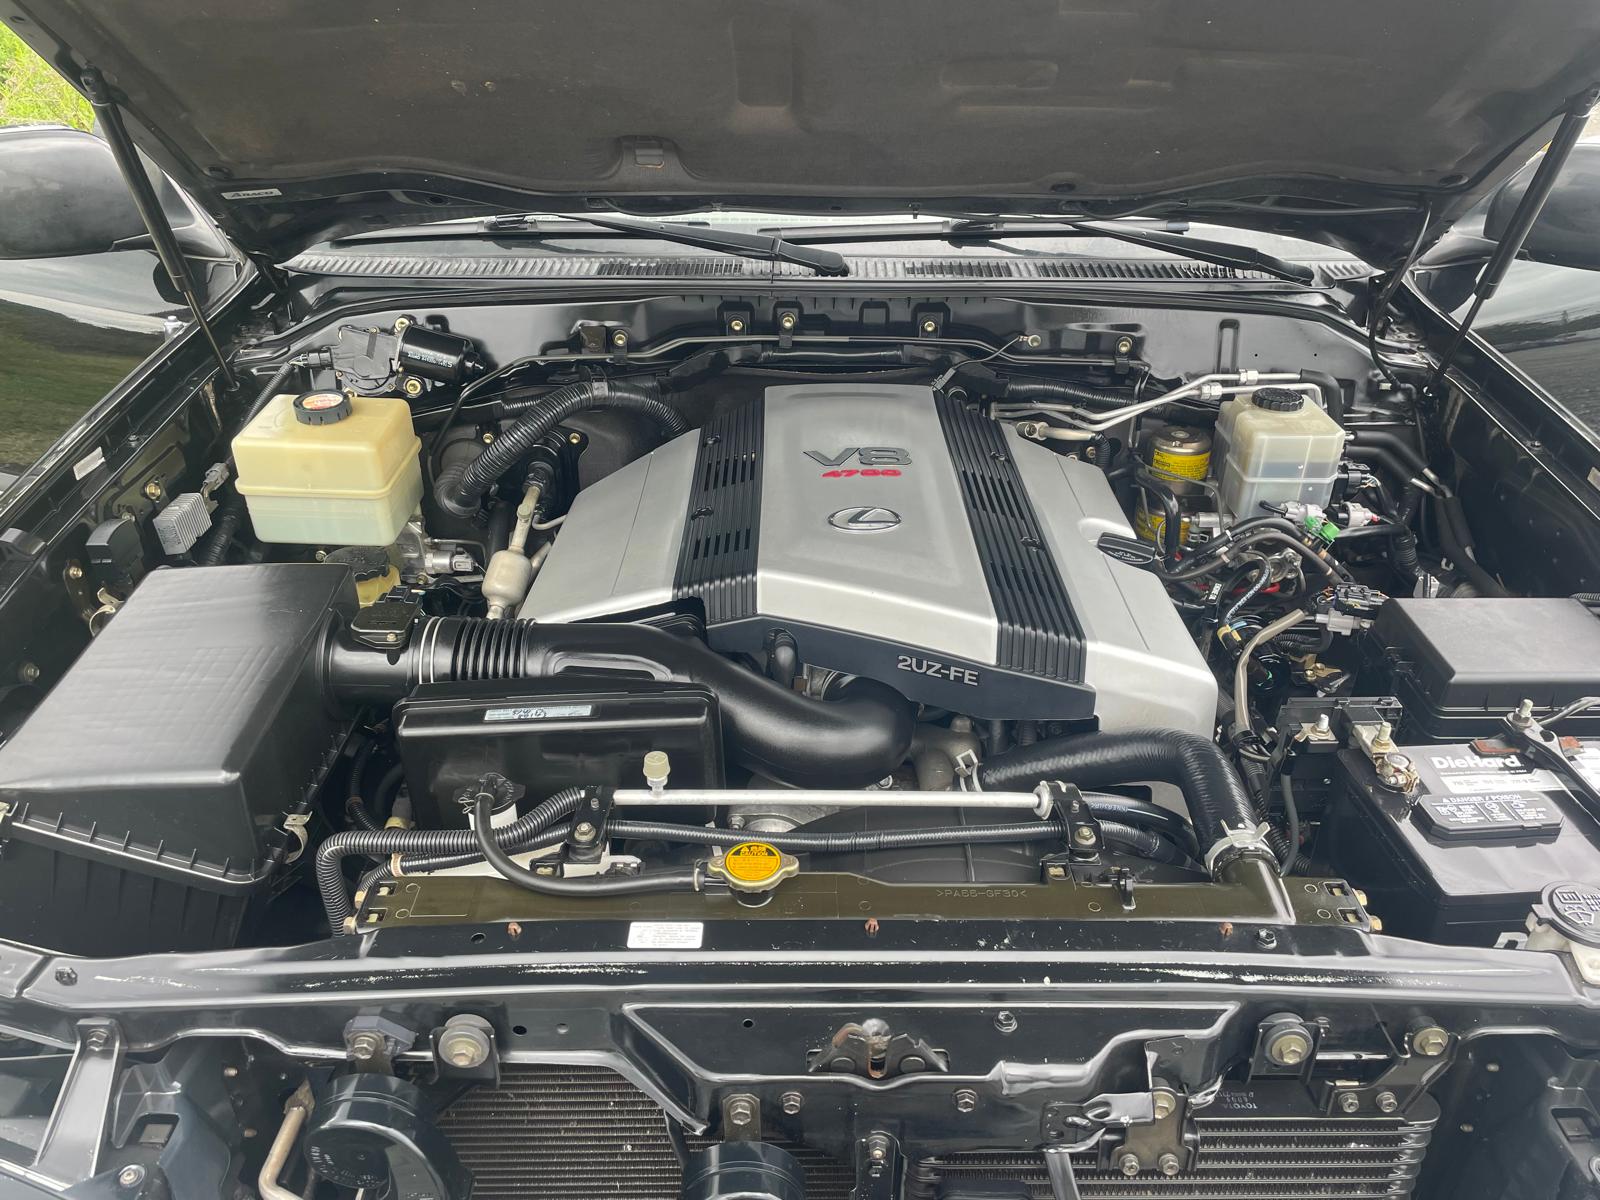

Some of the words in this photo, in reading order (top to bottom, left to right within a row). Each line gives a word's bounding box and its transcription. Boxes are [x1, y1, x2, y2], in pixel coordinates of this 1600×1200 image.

[803, 447, 912, 466] V8
[822, 469, 902, 478] 4700
[897, 655, 979, 686] 2UZ-FE
[1430, 755, 1521, 769] DieHard
